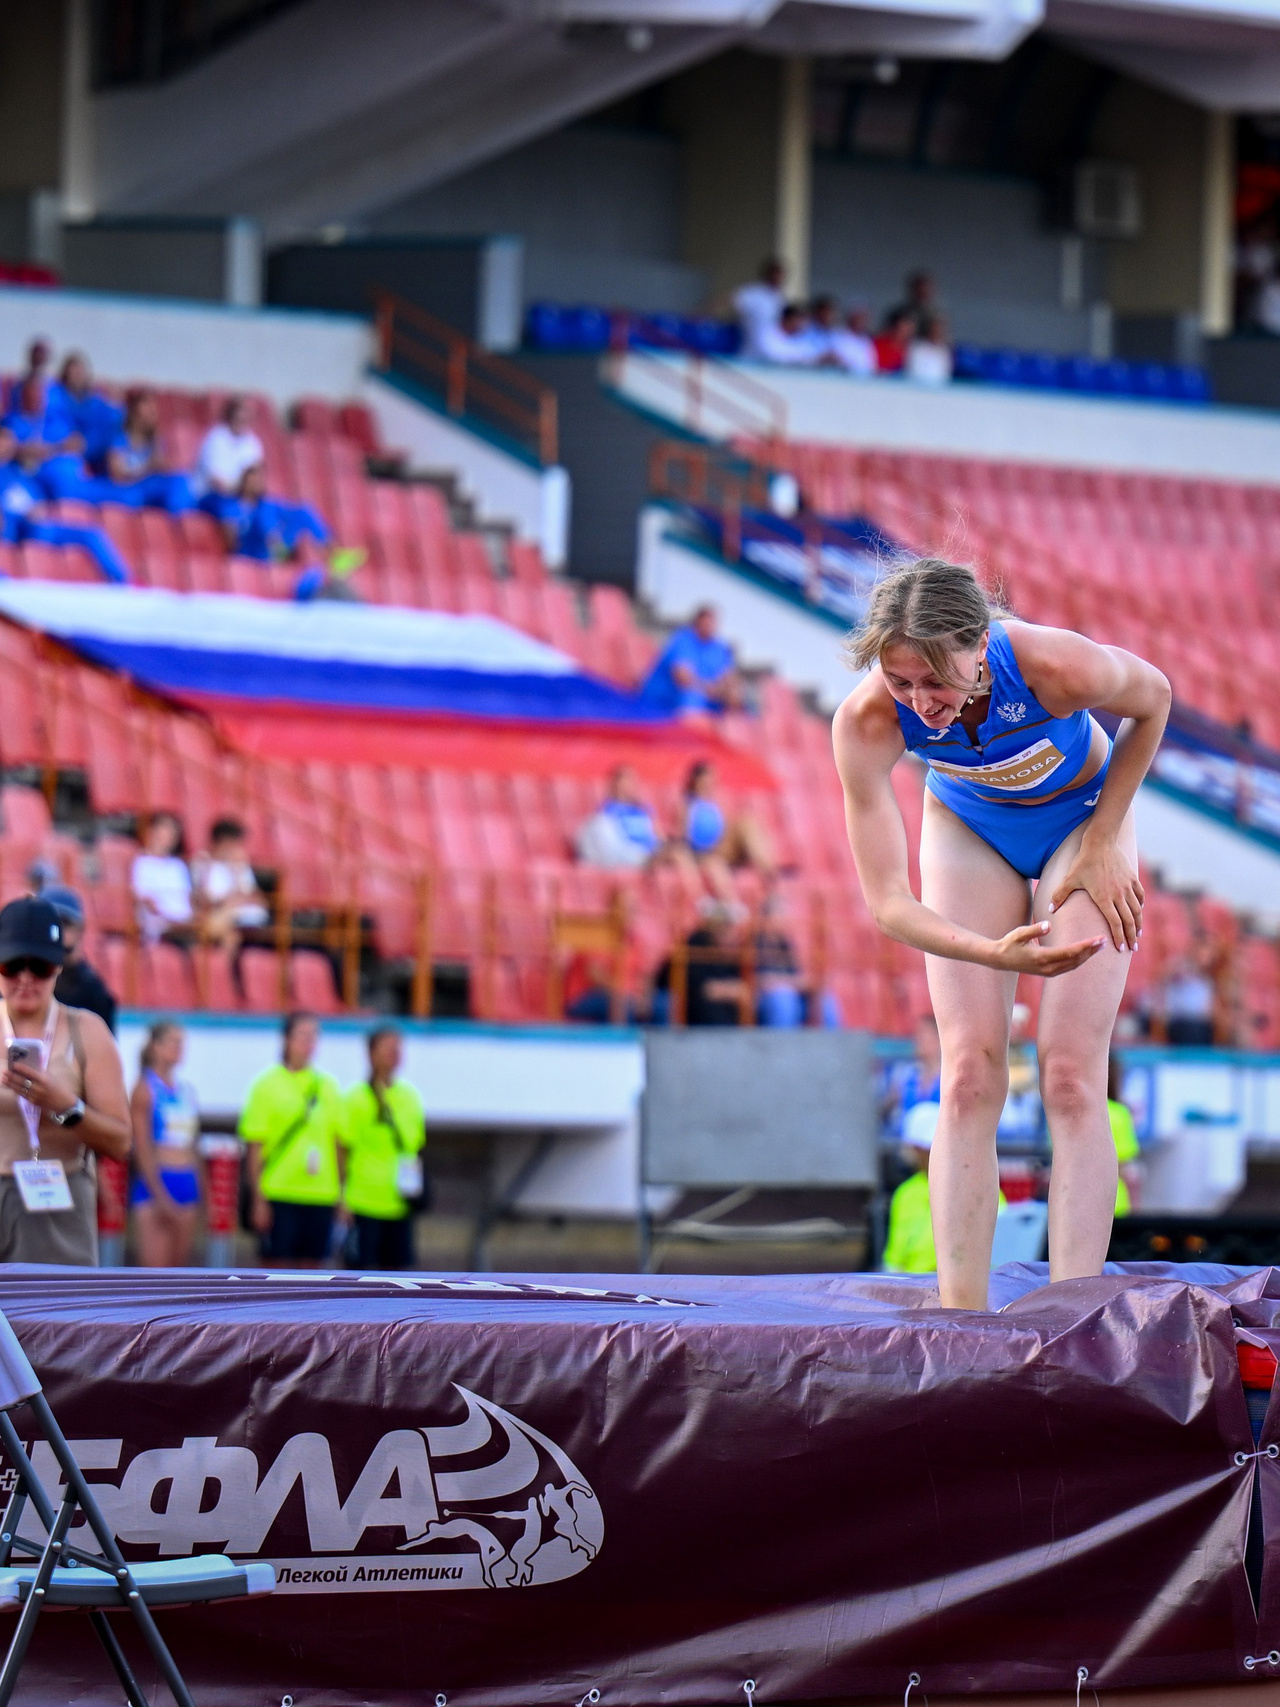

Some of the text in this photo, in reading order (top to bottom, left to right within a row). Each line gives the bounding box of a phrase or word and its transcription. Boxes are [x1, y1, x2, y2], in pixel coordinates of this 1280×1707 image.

[10, 1429, 440, 1555] БФЛА
[276, 1565, 464, 1584] Легкой Атлетики
